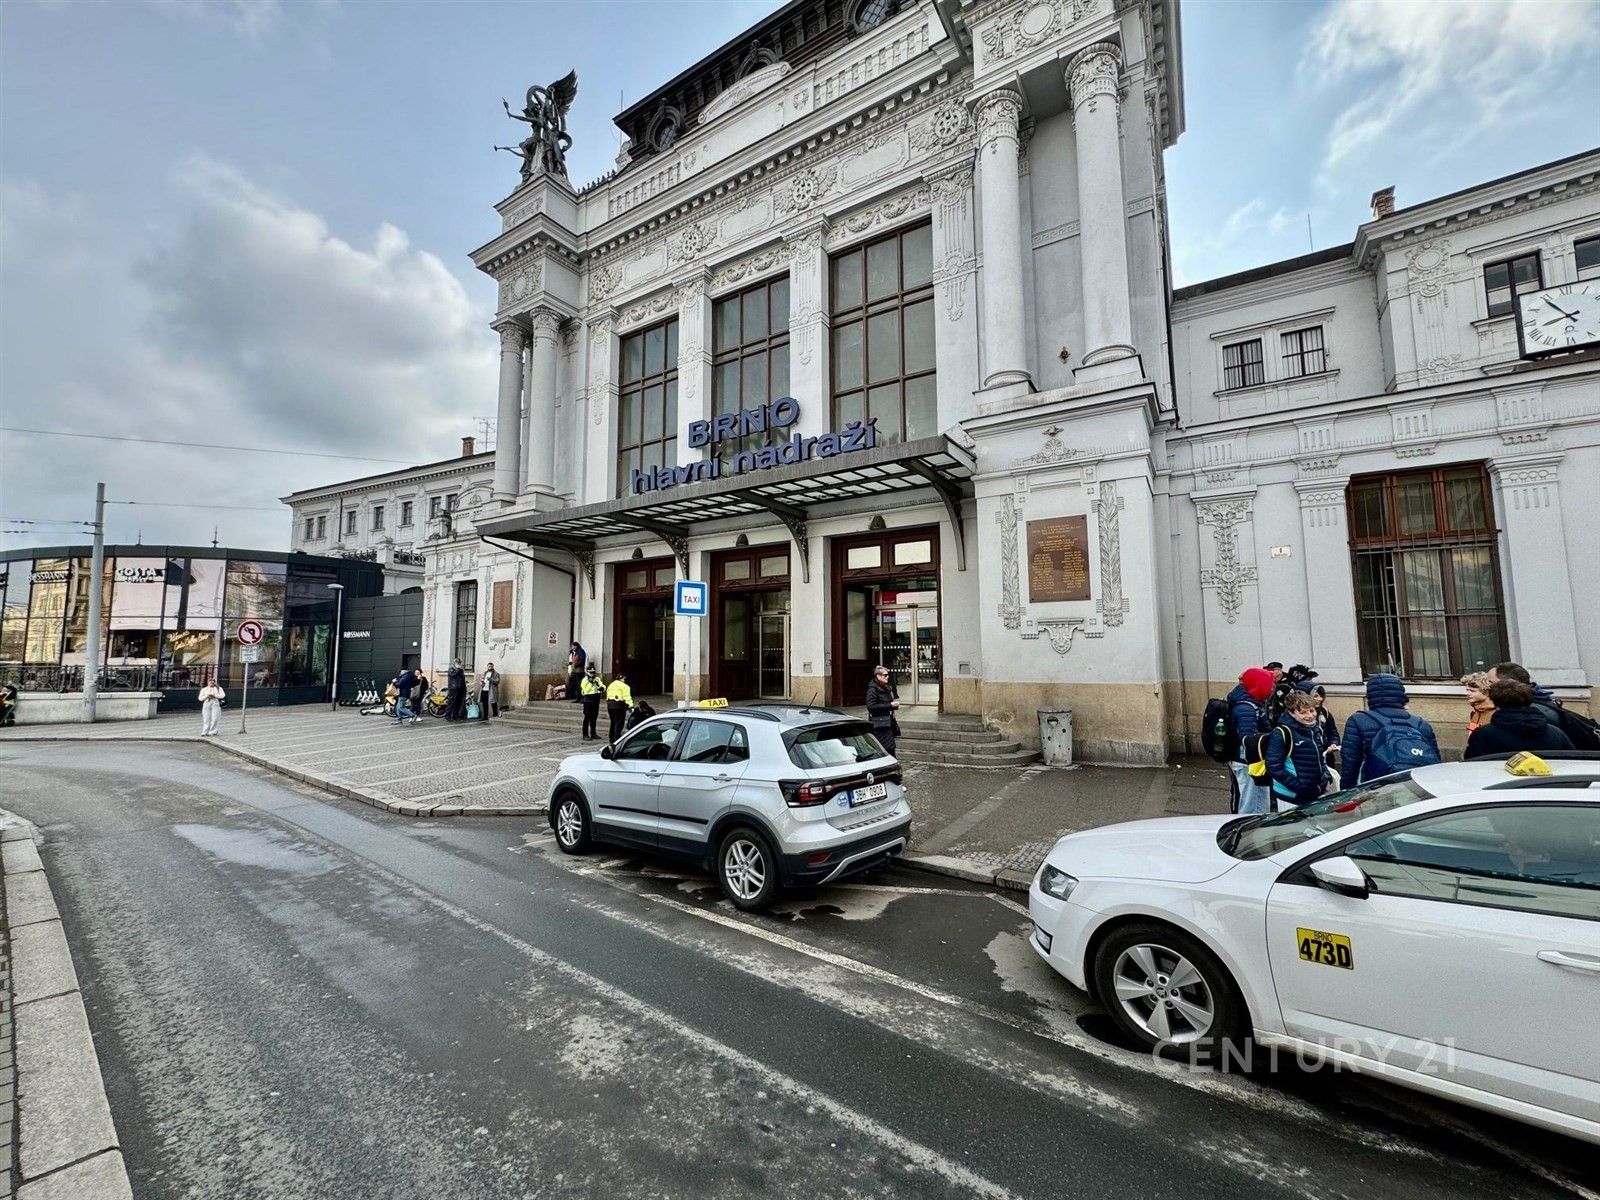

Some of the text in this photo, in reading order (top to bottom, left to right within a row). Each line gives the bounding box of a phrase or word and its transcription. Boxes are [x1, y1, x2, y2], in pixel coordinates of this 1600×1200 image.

[688, 397, 800, 449] BRNO
[631, 417, 879, 494] hlavní nádraží
[115, 568, 157, 579] COSTA
[684, 595, 700, 604] TAXI
[1314, 931, 1332, 943] BRNO
[1300, 938, 1351, 967] 473D
